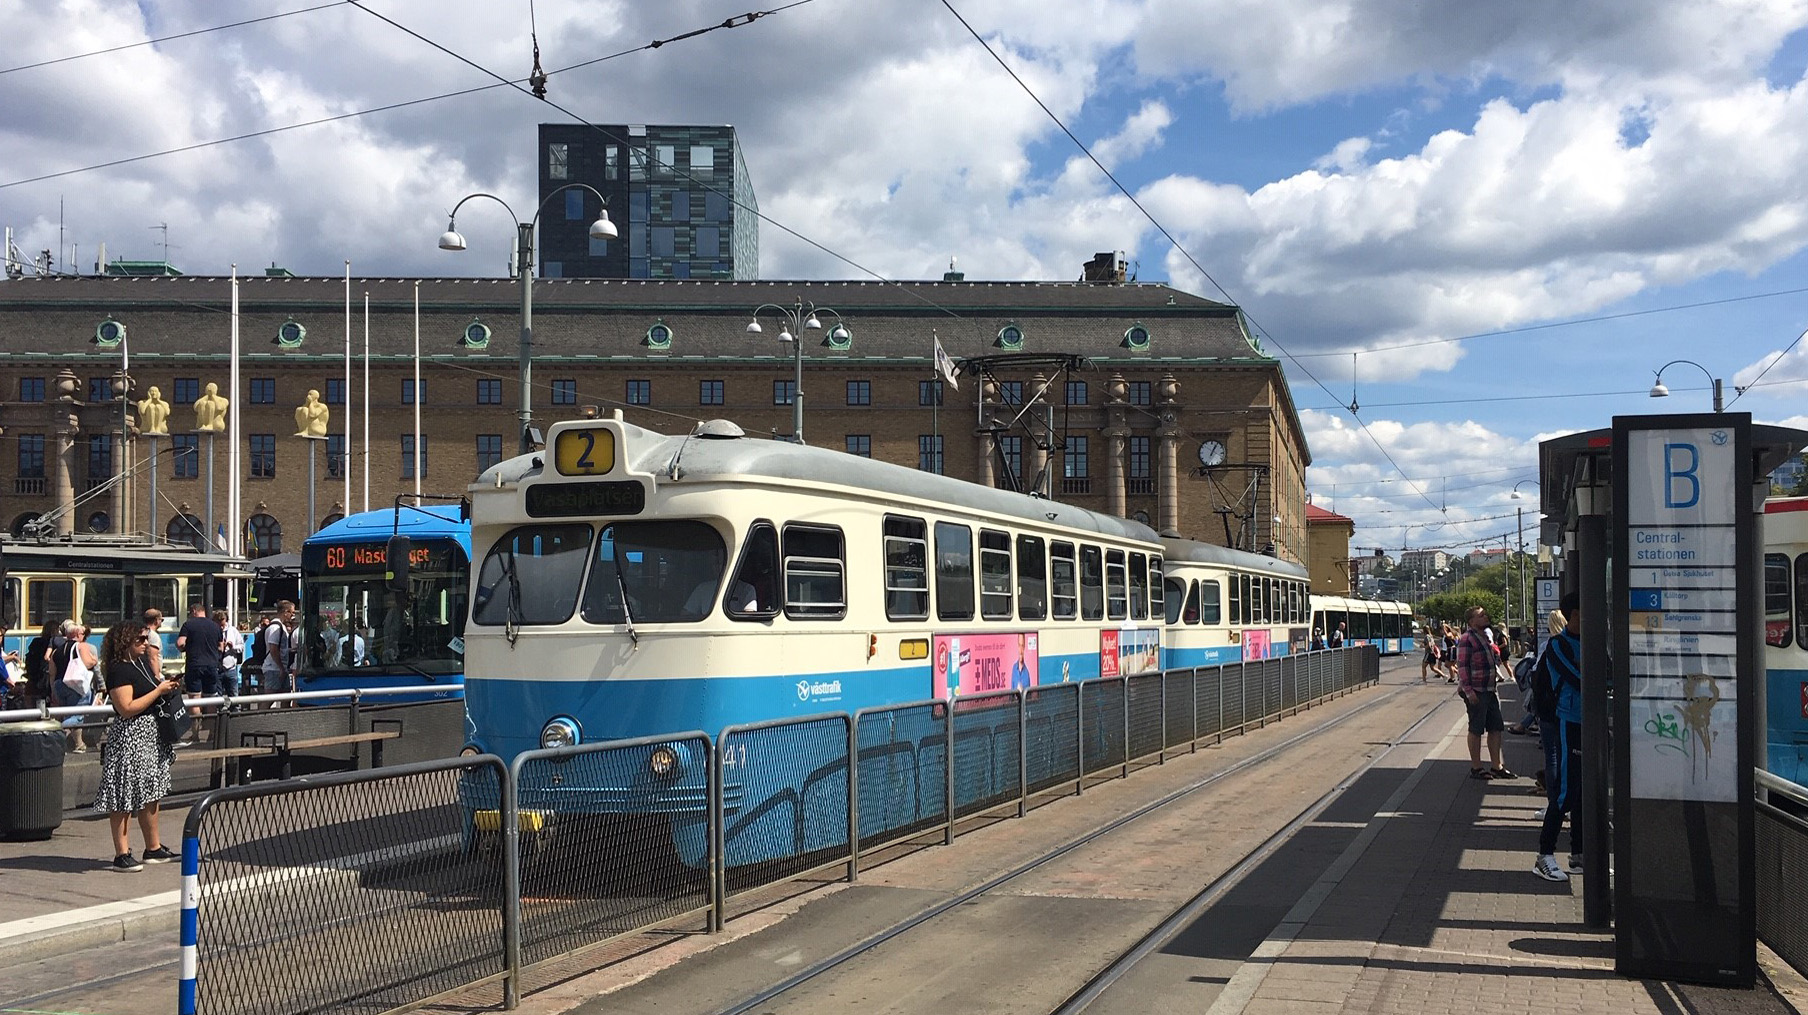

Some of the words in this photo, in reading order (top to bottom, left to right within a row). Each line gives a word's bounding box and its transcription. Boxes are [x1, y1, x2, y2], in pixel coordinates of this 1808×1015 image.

[577, 431, 595, 468] 2
[1664, 443, 1700, 509] B
[1636, 531, 1685, 544] Central-
[327, 547, 345, 568] 60
[1637, 549, 1695, 560] stationen
[67, 561, 114, 569] Centralstationen
[1651, 571, 1657, 584] 1
[1543, 582, 1553, 597] B
[1650, 593, 1658, 607] 3
[1645, 615, 1659, 628] 13
[811, 679, 842, 695] västtrafik
